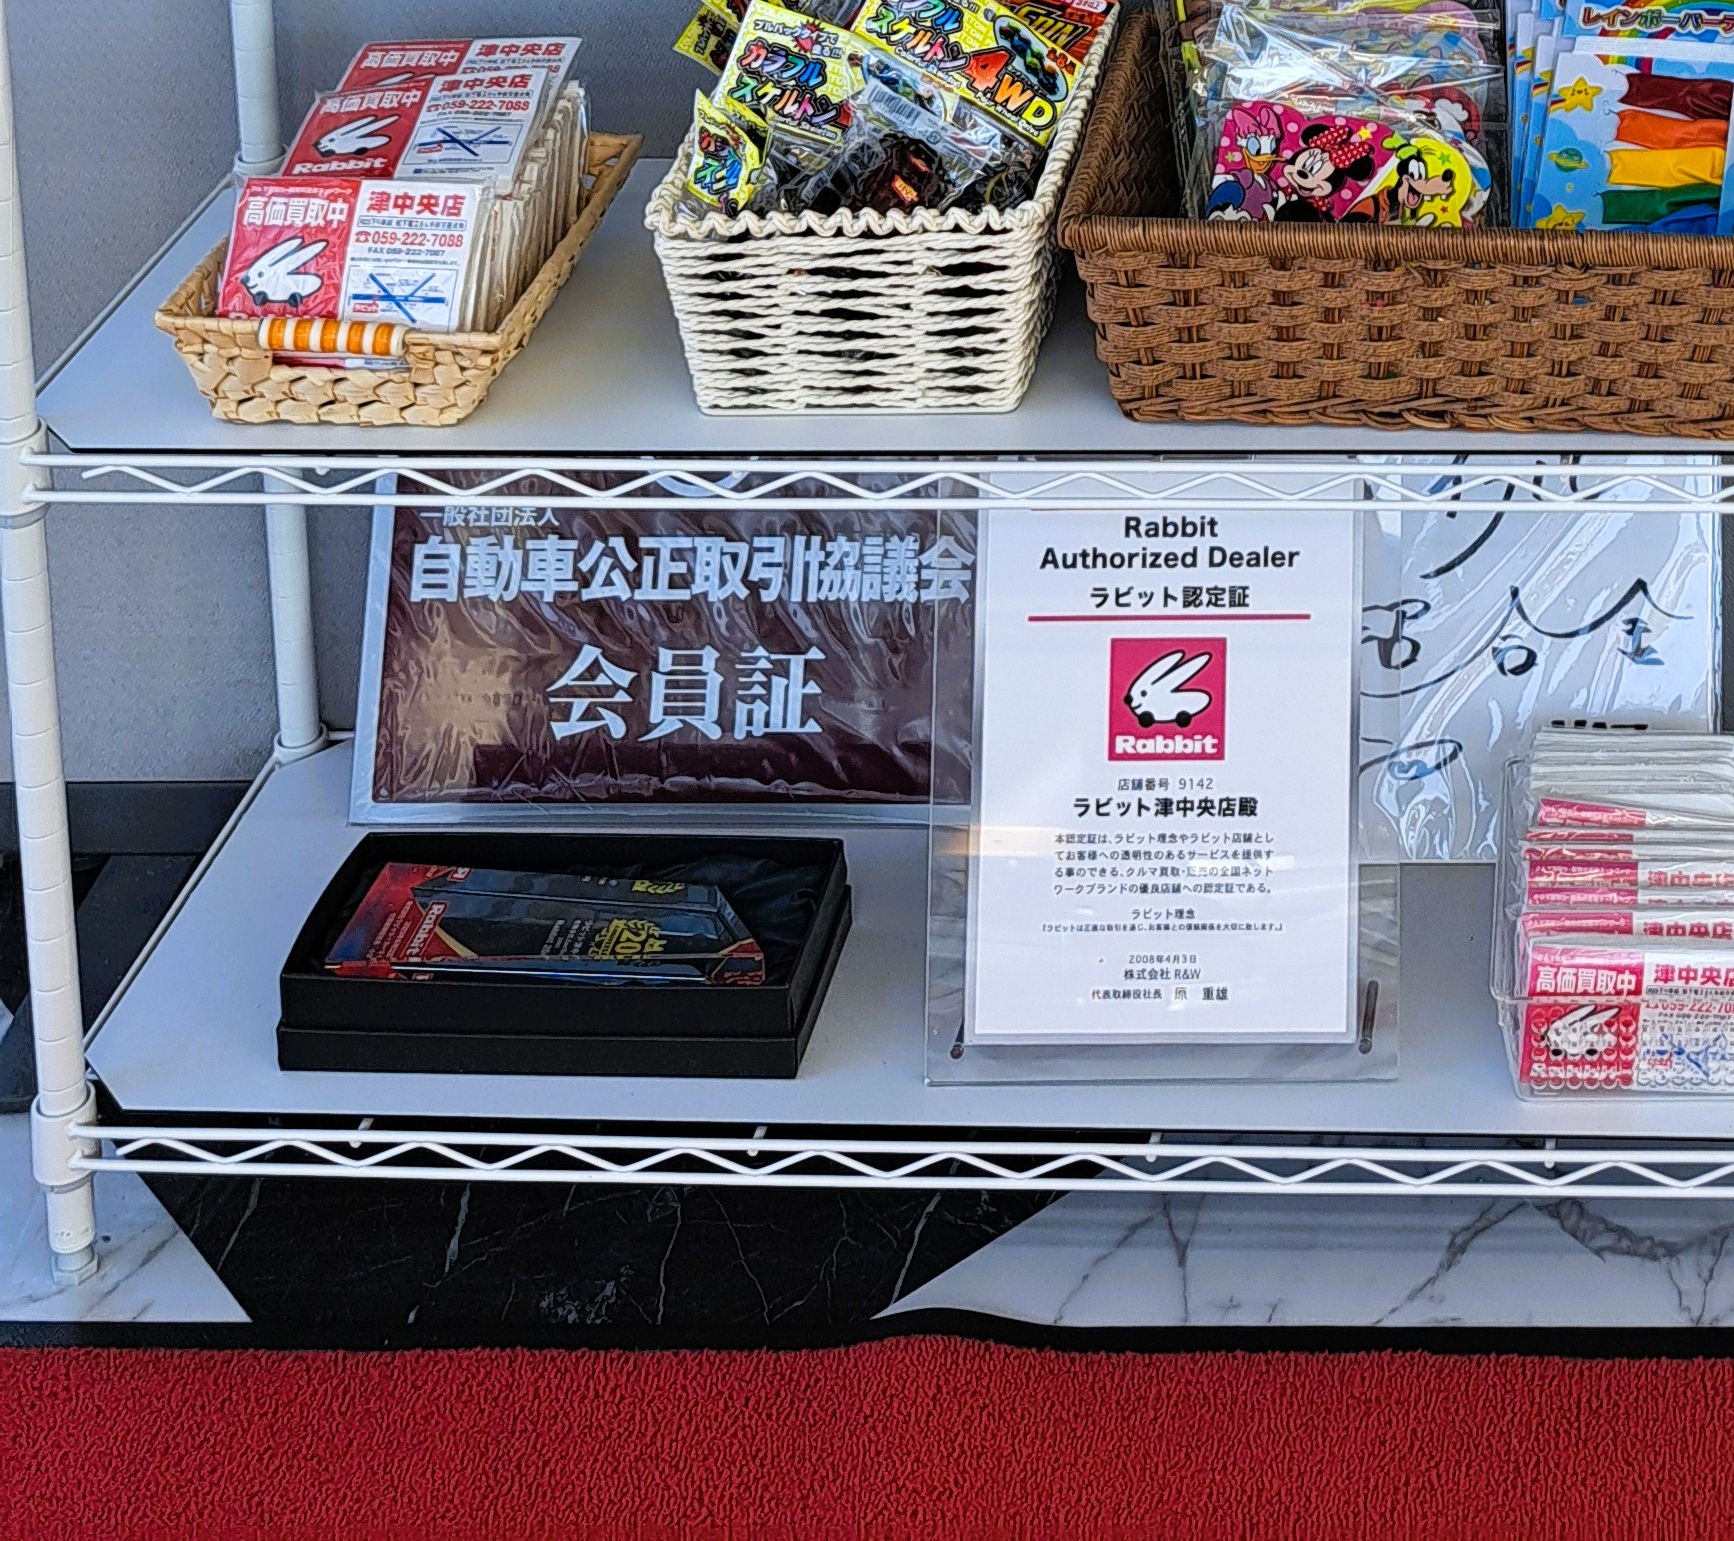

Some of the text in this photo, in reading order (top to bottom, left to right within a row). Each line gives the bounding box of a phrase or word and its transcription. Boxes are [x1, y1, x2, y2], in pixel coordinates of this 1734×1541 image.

[963, 47, 1057, 129] 4WD
[369, 192, 465, 216] 津中央店
[373, 233, 463, 247] 059-222-7088
[1124, 516, 1218, 538] Rabbit
[410, 535, 975, 604] 自動車公正取引協議会
[1040, 547, 1299, 570] Authorized Dealer
[1090, 586, 1249, 609] ラビット認定証
[547, 645, 825, 741] 会員証
[1115, 735, 1218, 754] Rabbit
[1118, 778, 1213, 790] 店舗番号 9142
[1074, 798, 1258, 817] ラビット津中央店殿
[1132, 909, 1195, 919] ラビット理念
[1124, 968, 1201, 980] 株式会社 R&W
[1536, 967, 1636, 995] 高価買取中
[1092, 989, 1162, 999] 代表取締役社長
